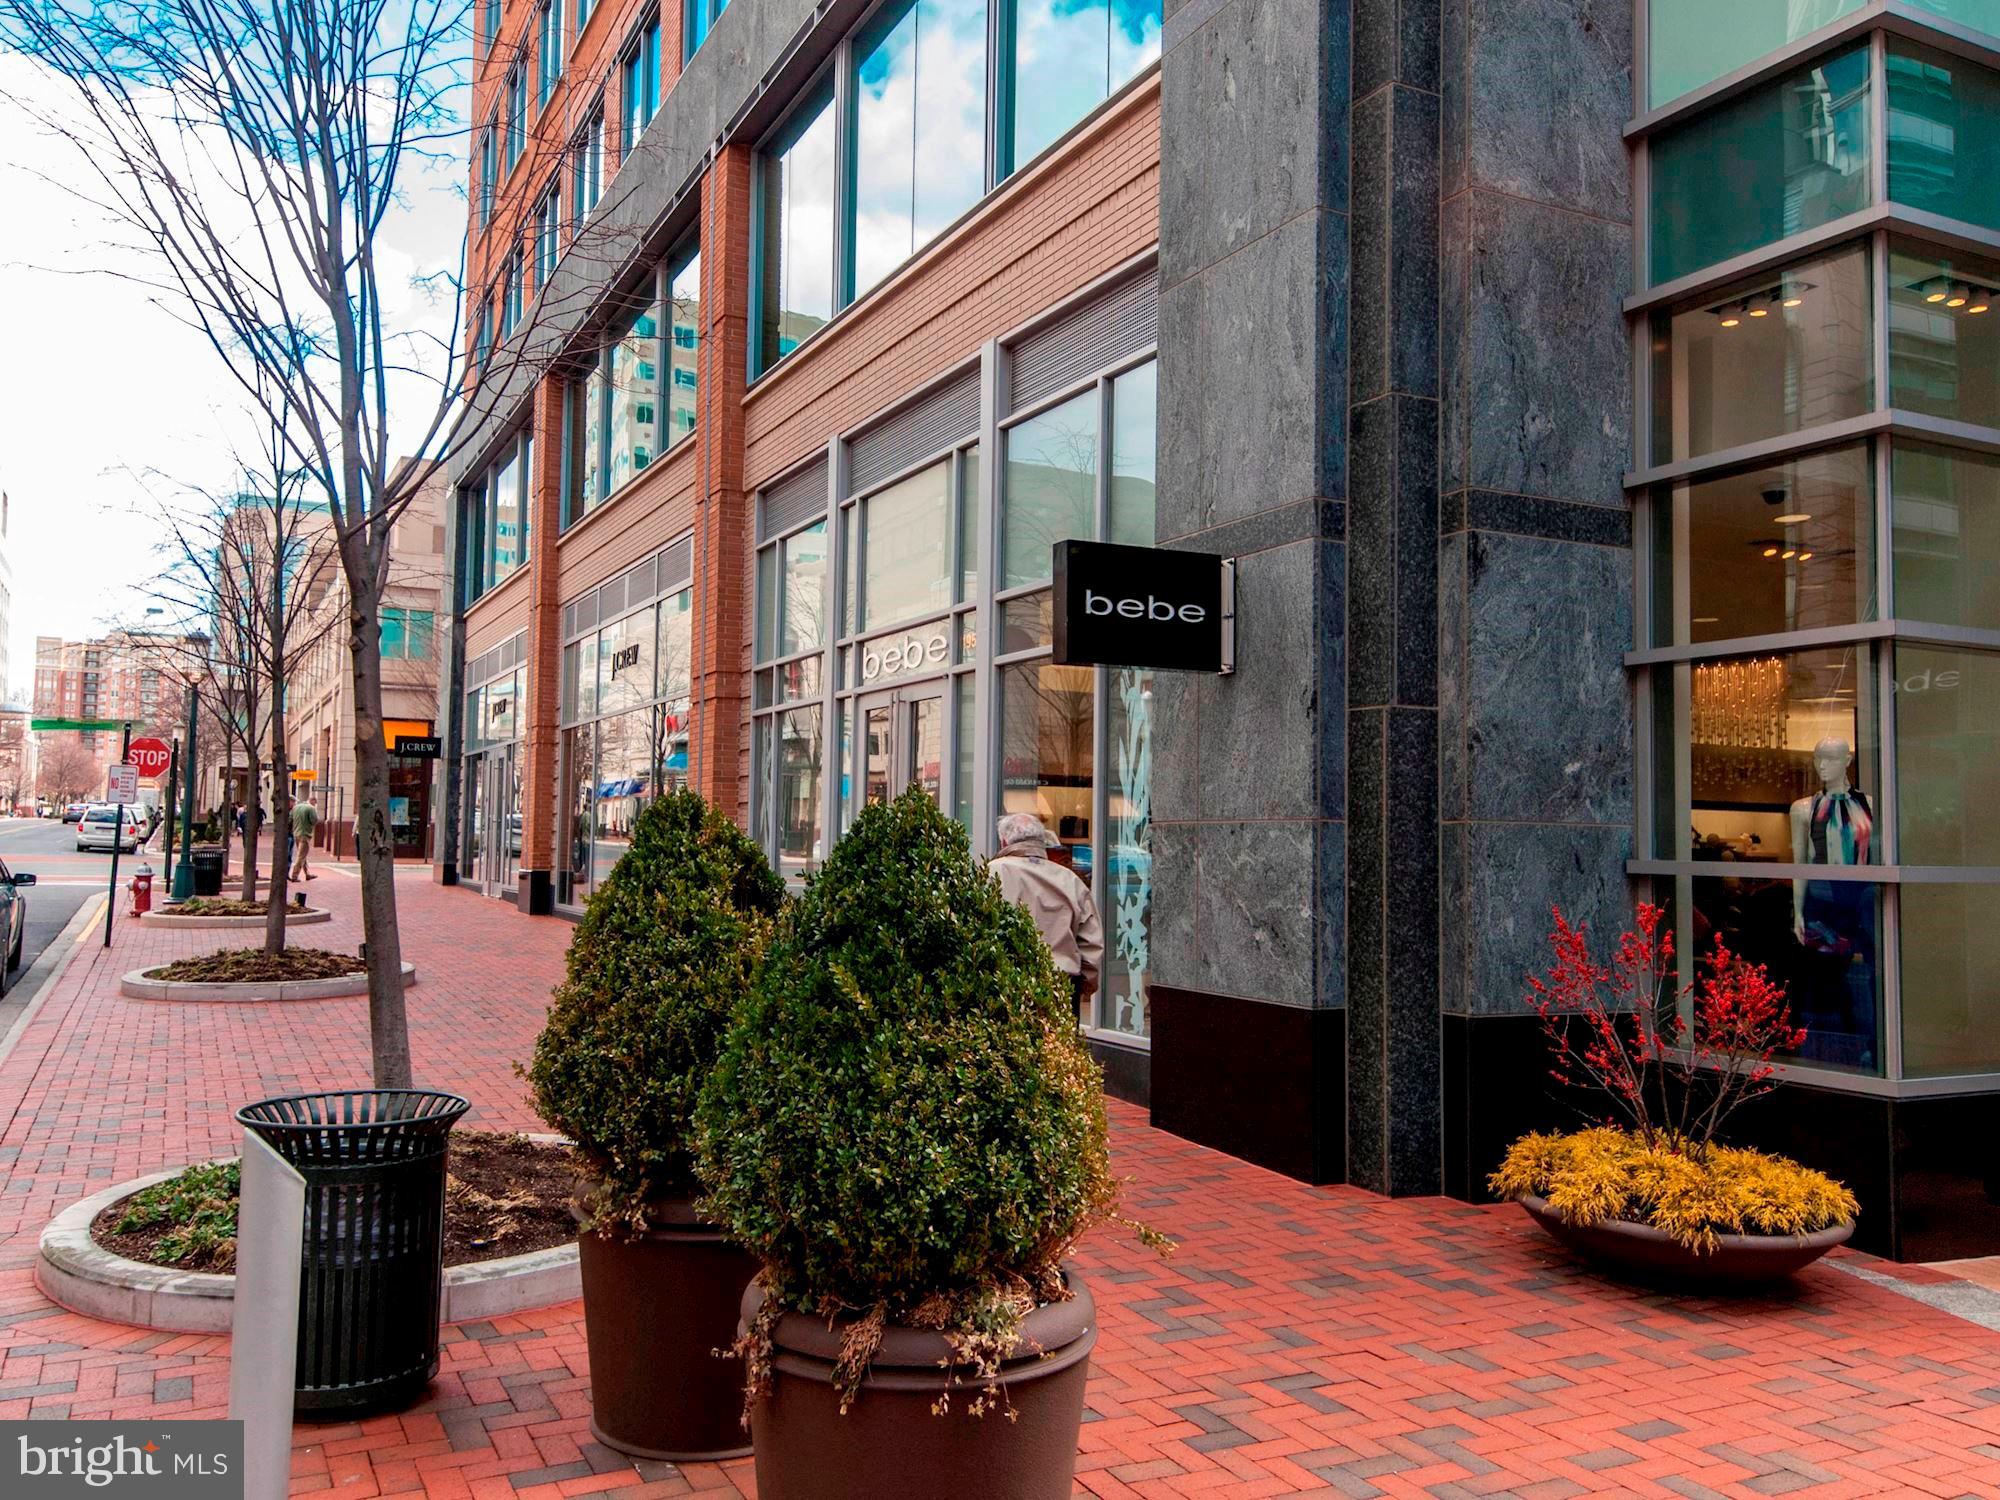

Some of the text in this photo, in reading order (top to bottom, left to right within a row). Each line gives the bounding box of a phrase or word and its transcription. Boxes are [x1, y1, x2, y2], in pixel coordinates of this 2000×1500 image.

[1085, 589, 1206, 623] bebe
[863, 635, 950, 680] bebe
[128, 749, 168, 766] STOP
[400, 742, 436, 753] J.CREW
